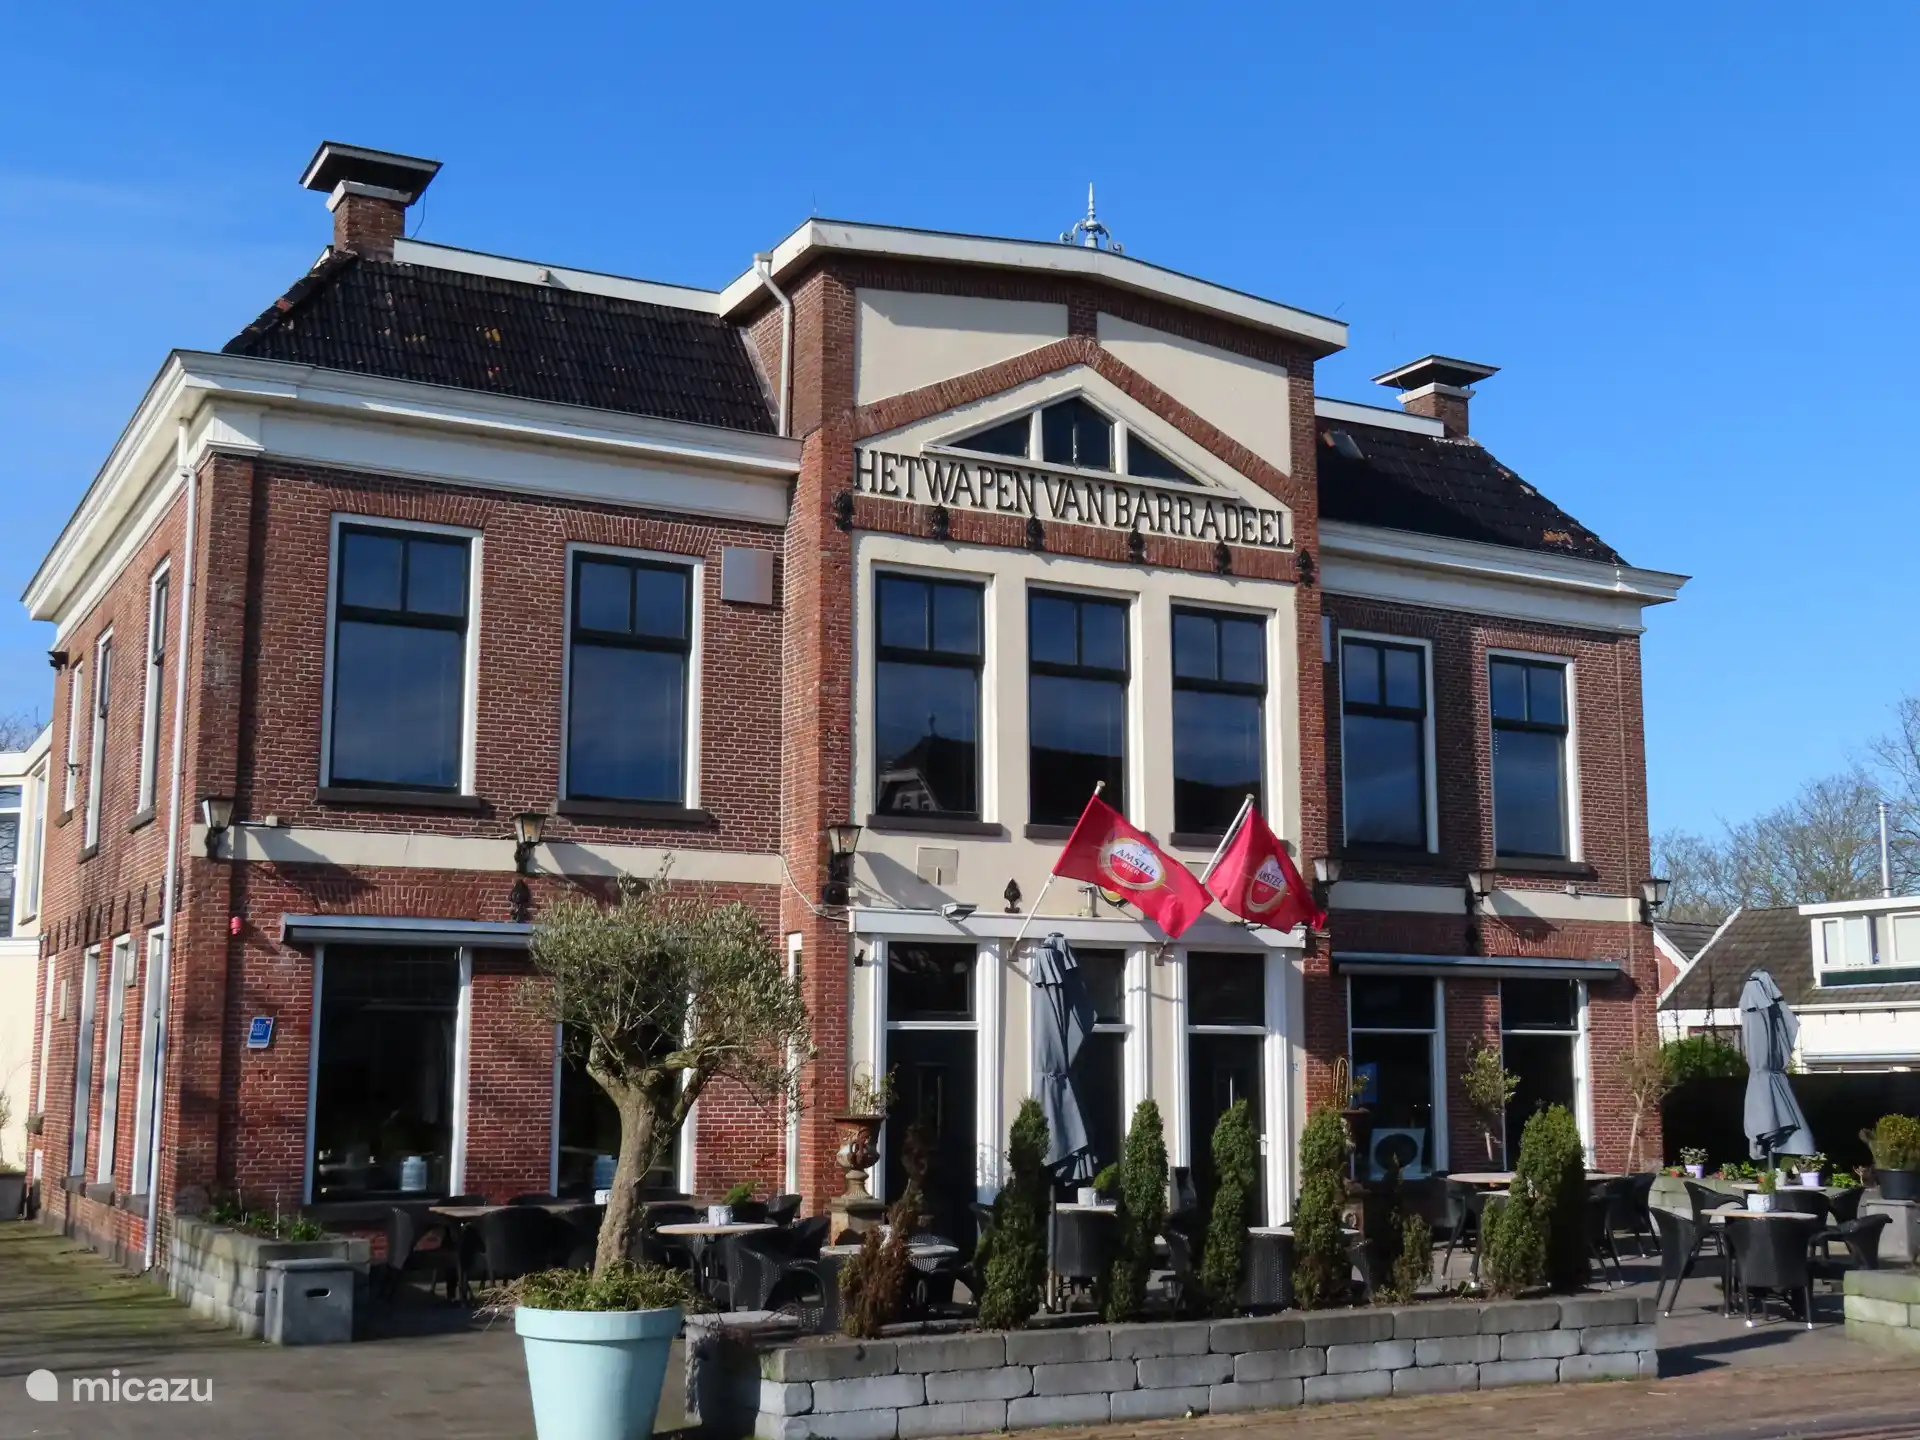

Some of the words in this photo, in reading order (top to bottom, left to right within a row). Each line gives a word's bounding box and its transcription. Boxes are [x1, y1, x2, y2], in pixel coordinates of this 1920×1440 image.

[854, 447, 920, 498] HET
[920, 457, 1036, 516] WAPEN
[1041, 474, 1107, 525] VAN
[1113, 487, 1294, 548] BARRADEEL
[1116, 849, 1157, 876] AMSTEL
[1121, 862, 1141, 876] BIER
